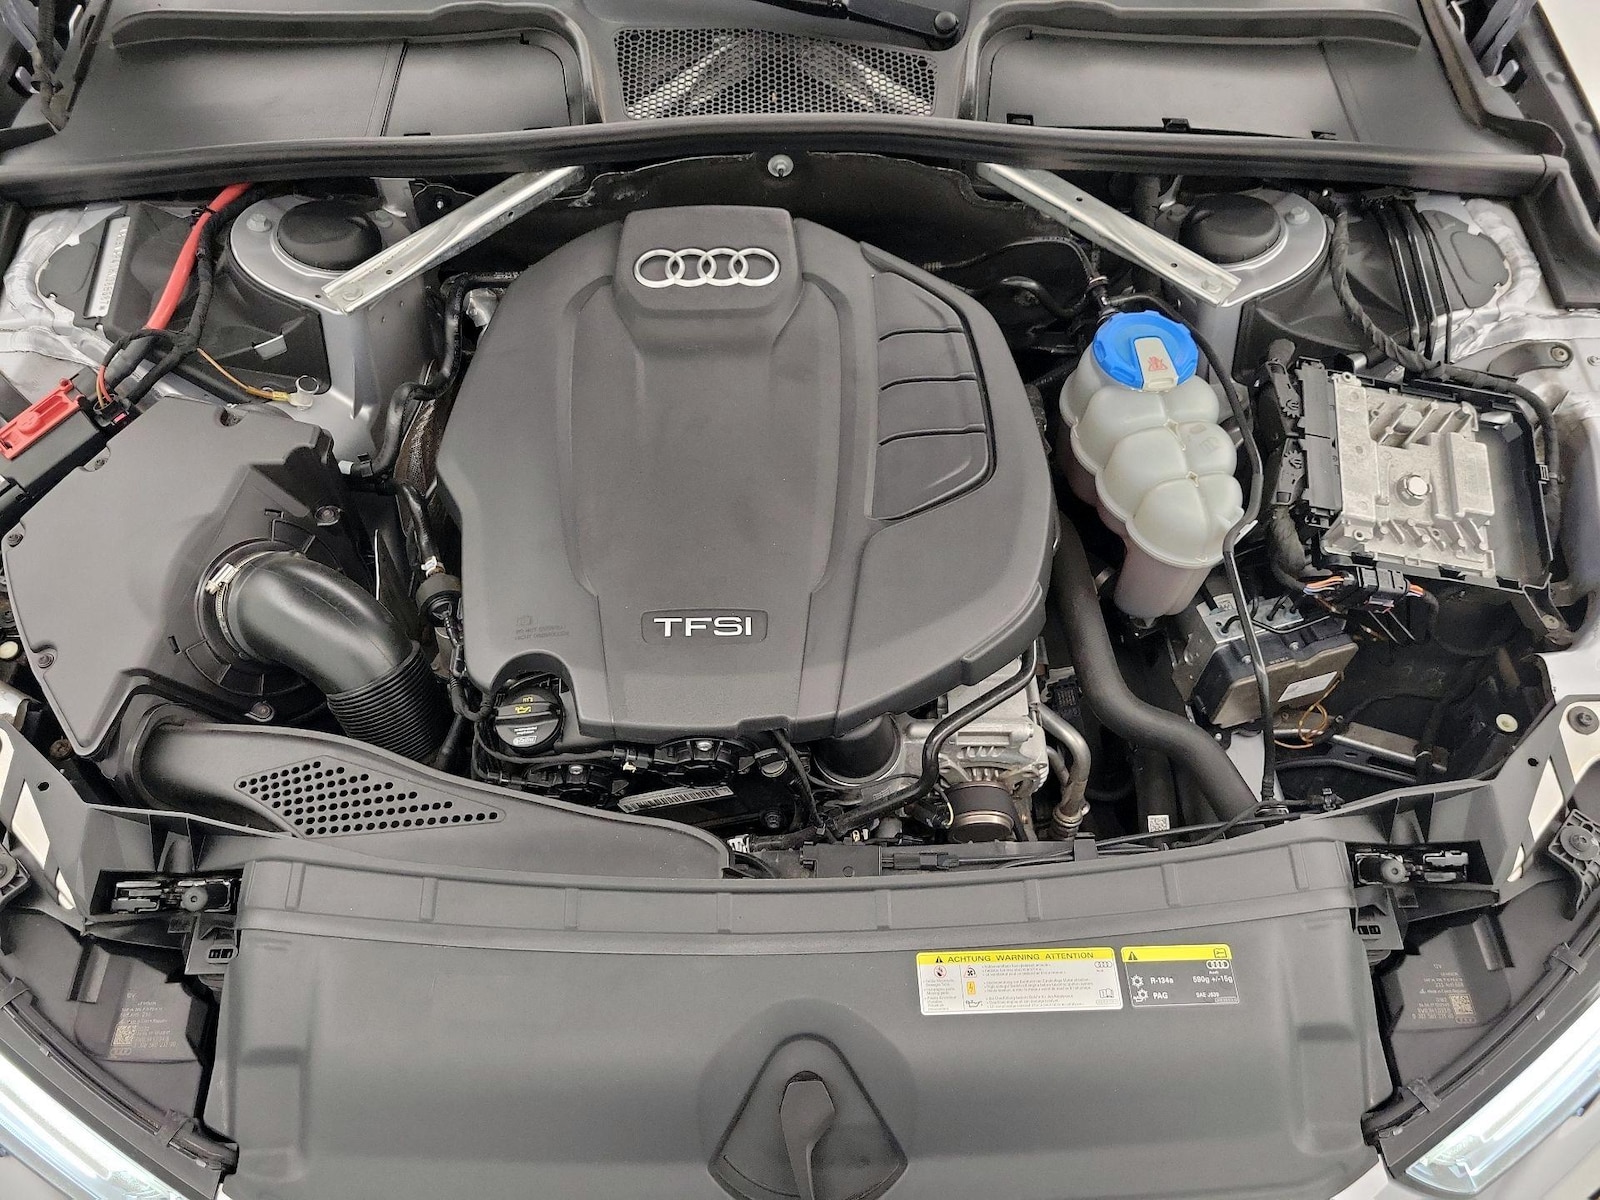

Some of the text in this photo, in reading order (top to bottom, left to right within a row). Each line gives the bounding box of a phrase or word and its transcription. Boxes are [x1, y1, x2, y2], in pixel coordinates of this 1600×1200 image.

[653, 616, 752, 638] TFSI
[947, 951, 1094, 963] ACHTUNG WARNING ATTENTION
[1150, 976, 1174, 985] R-134a
[1152, 991, 1169, 1000] PAG
